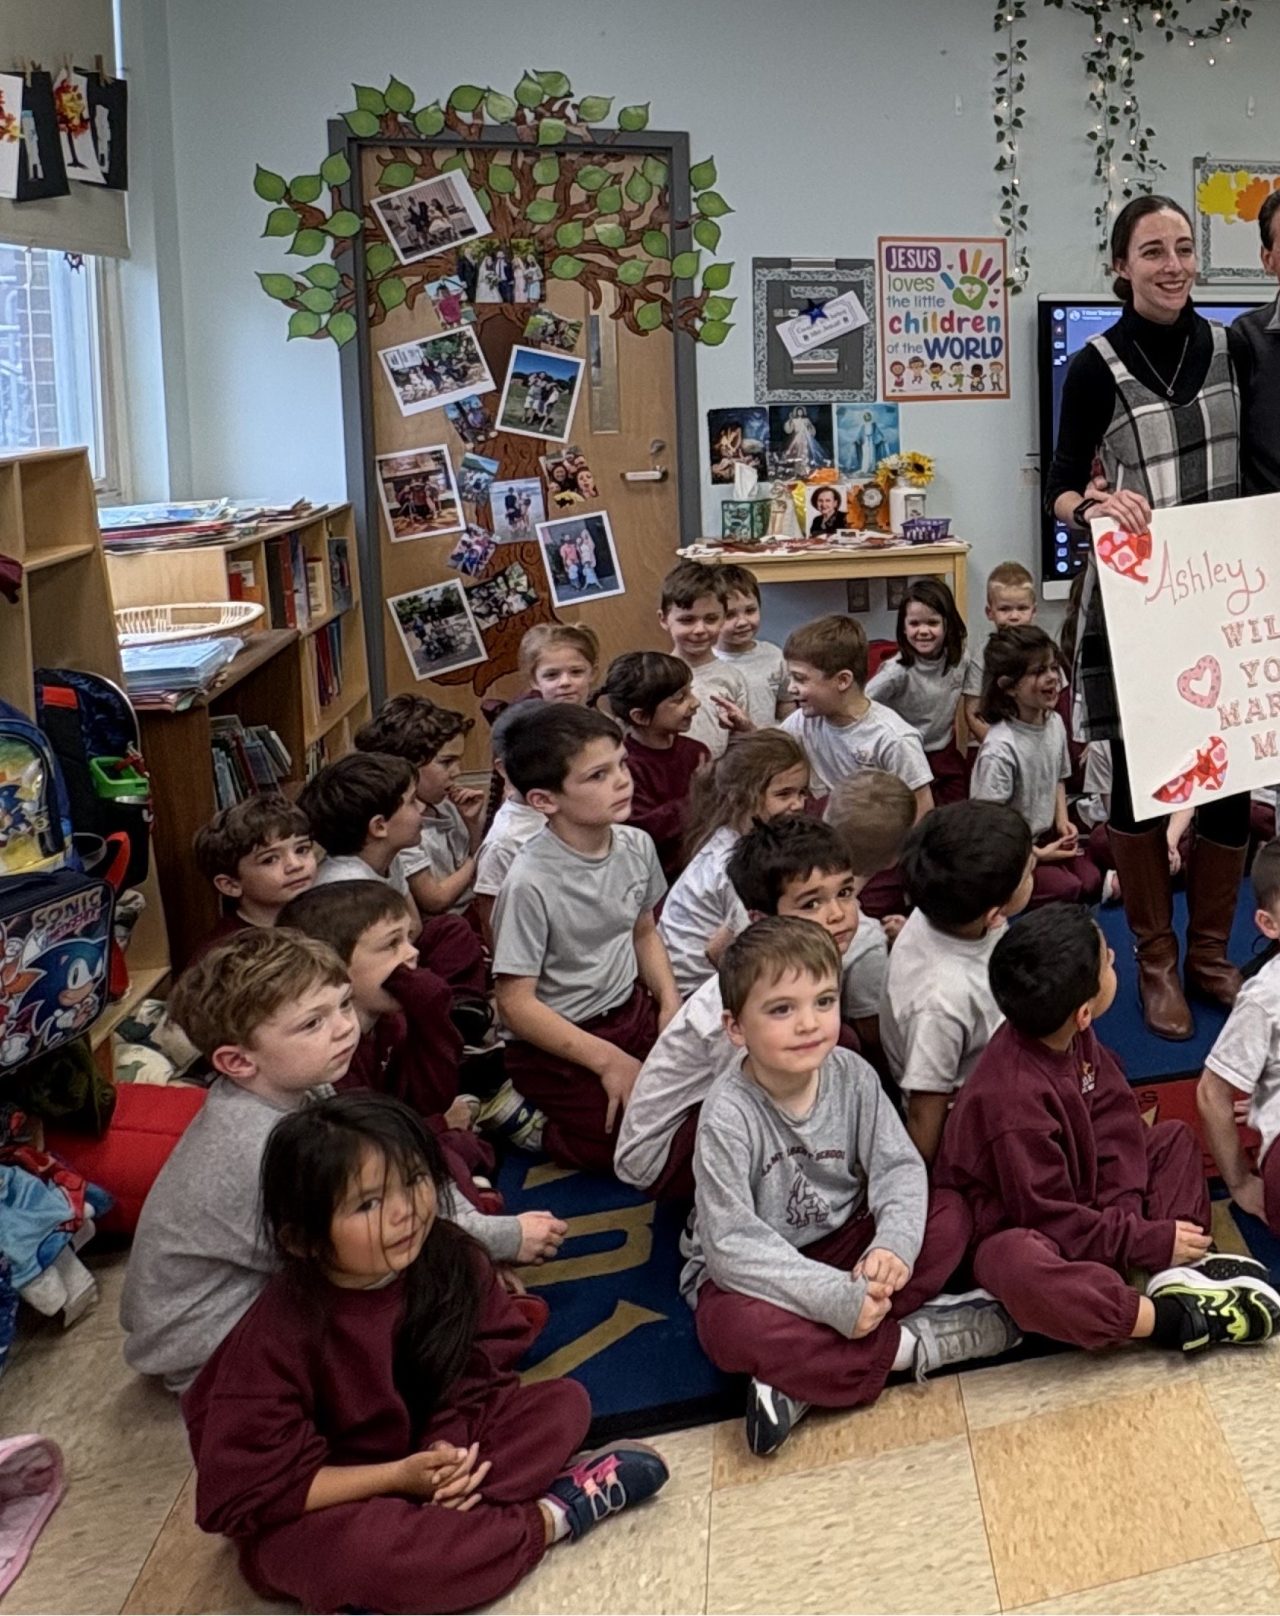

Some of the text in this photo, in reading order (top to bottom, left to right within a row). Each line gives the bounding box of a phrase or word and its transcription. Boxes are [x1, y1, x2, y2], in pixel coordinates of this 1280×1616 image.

[889, 248, 937, 269] JESUS
[888, 274, 935, 292] loves
[887, 295, 945, 308] the little
[889, 310, 1001, 334] children
[887, 336, 1003, 361] of the WORLD
[1145, 540, 1267, 616] Ashley
[35, 888, 102, 929] SONIC
